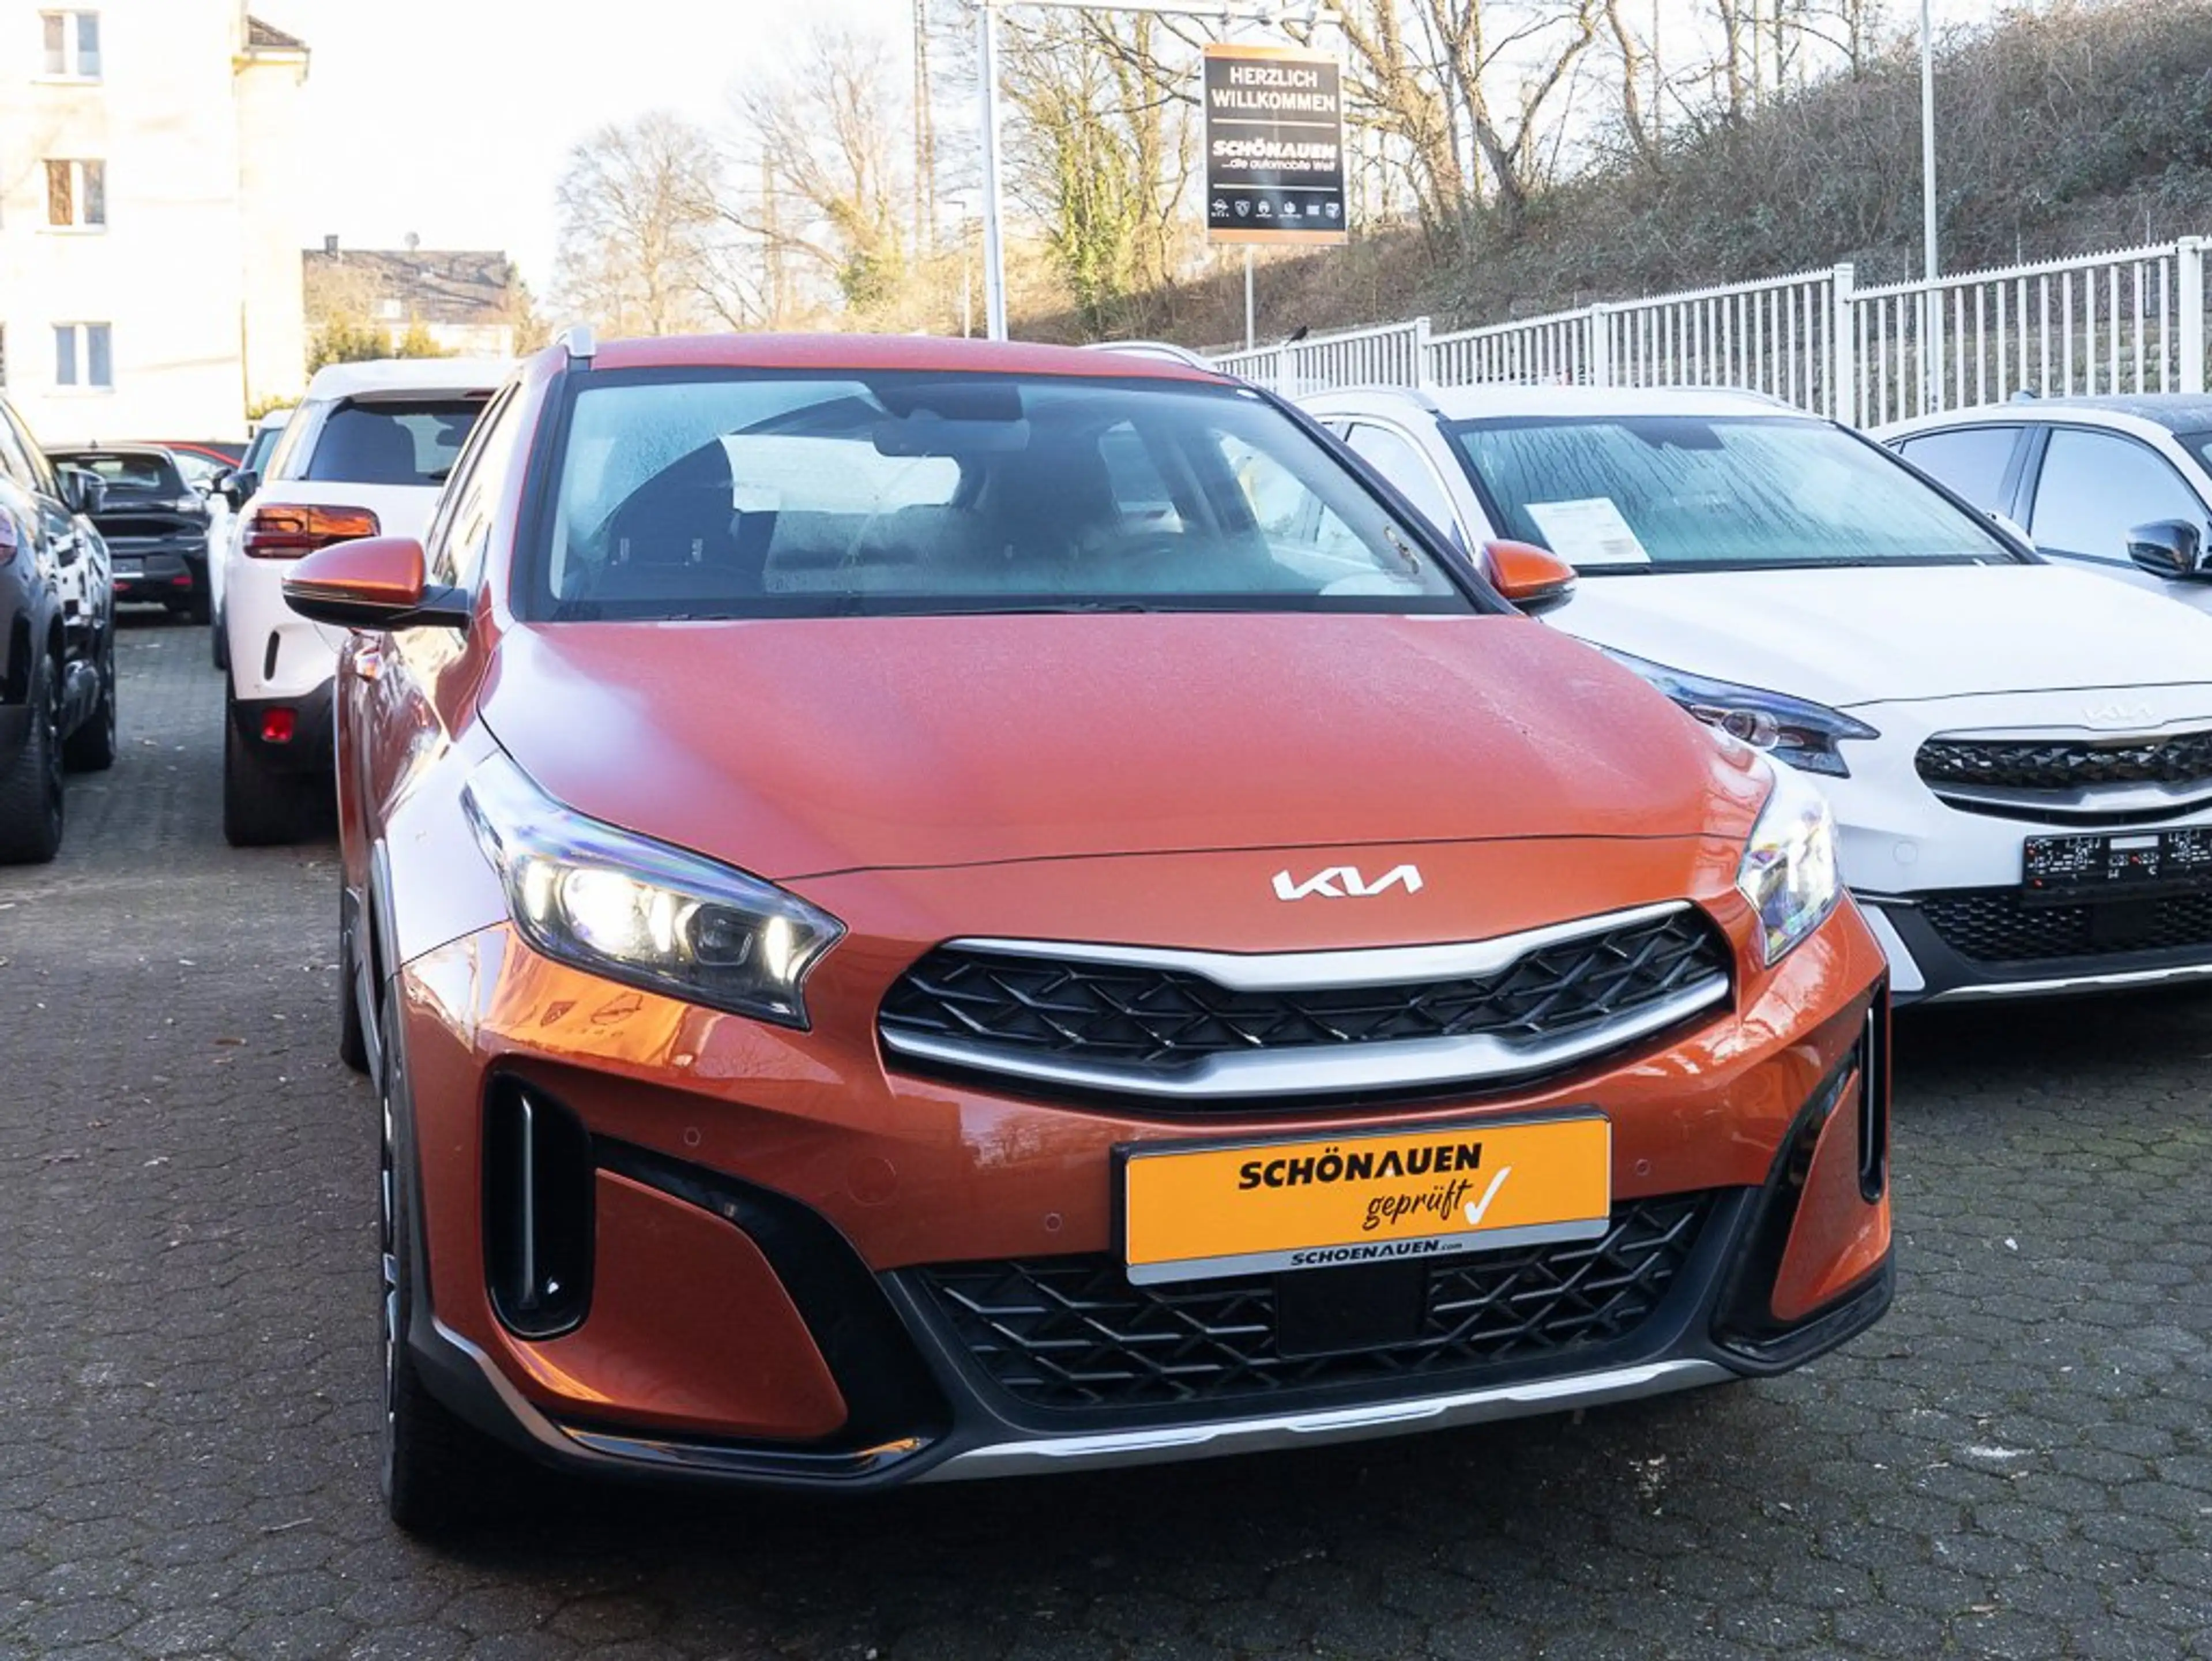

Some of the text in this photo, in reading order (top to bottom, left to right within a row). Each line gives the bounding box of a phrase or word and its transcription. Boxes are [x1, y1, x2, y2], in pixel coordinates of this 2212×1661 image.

[1230, 66, 1318, 88] HERZLICH
[1212, 88, 1336, 112] WILLKOMMEN
[1213, 137, 1337, 159] SCHÖNAUEN
[1272, 865, 1423, 900] KIA
[1239, 1143, 1483, 1190] SCHÖNAUEN
[1362, 1178, 1474, 1231] geprüft
